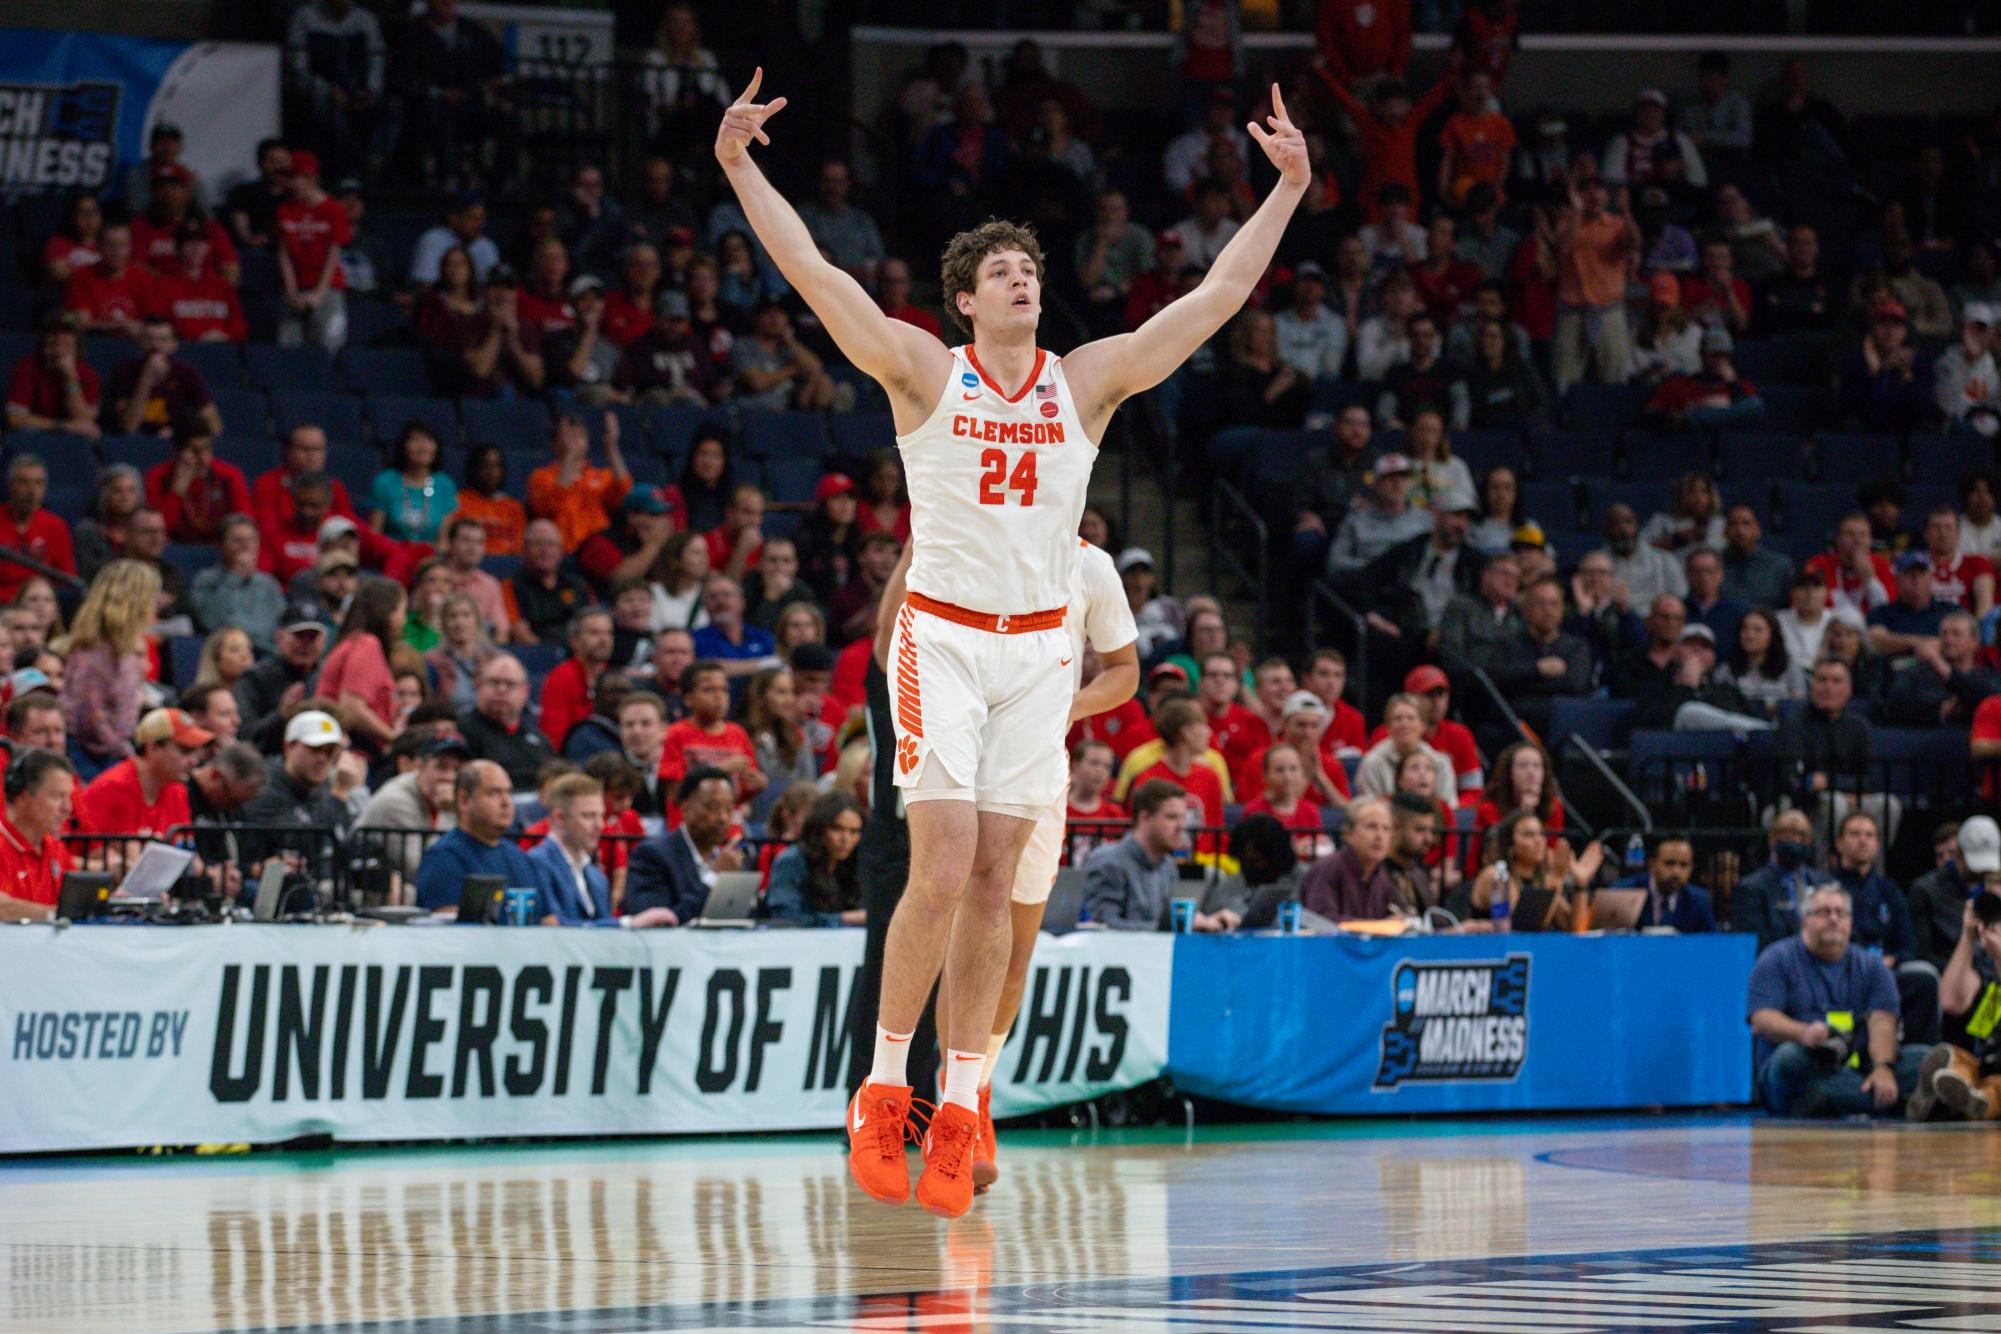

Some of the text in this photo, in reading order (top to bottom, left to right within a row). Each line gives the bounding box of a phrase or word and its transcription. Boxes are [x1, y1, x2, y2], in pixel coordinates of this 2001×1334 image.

[0, 139, 111, 188] NESS
[952, 415, 1065, 444] CLEMSON
[979, 448, 1038, 506] 24
[996, 613, 1010, 632] C
[1414, 968, 1492, 1017] MARCH
[13, 1010, 190, 1060] HOSTED BY
[209, 964, 1132, 1103] UNIVERSITY OF MHIS
[1419, 1015, 1526, 1063] MADNESS
